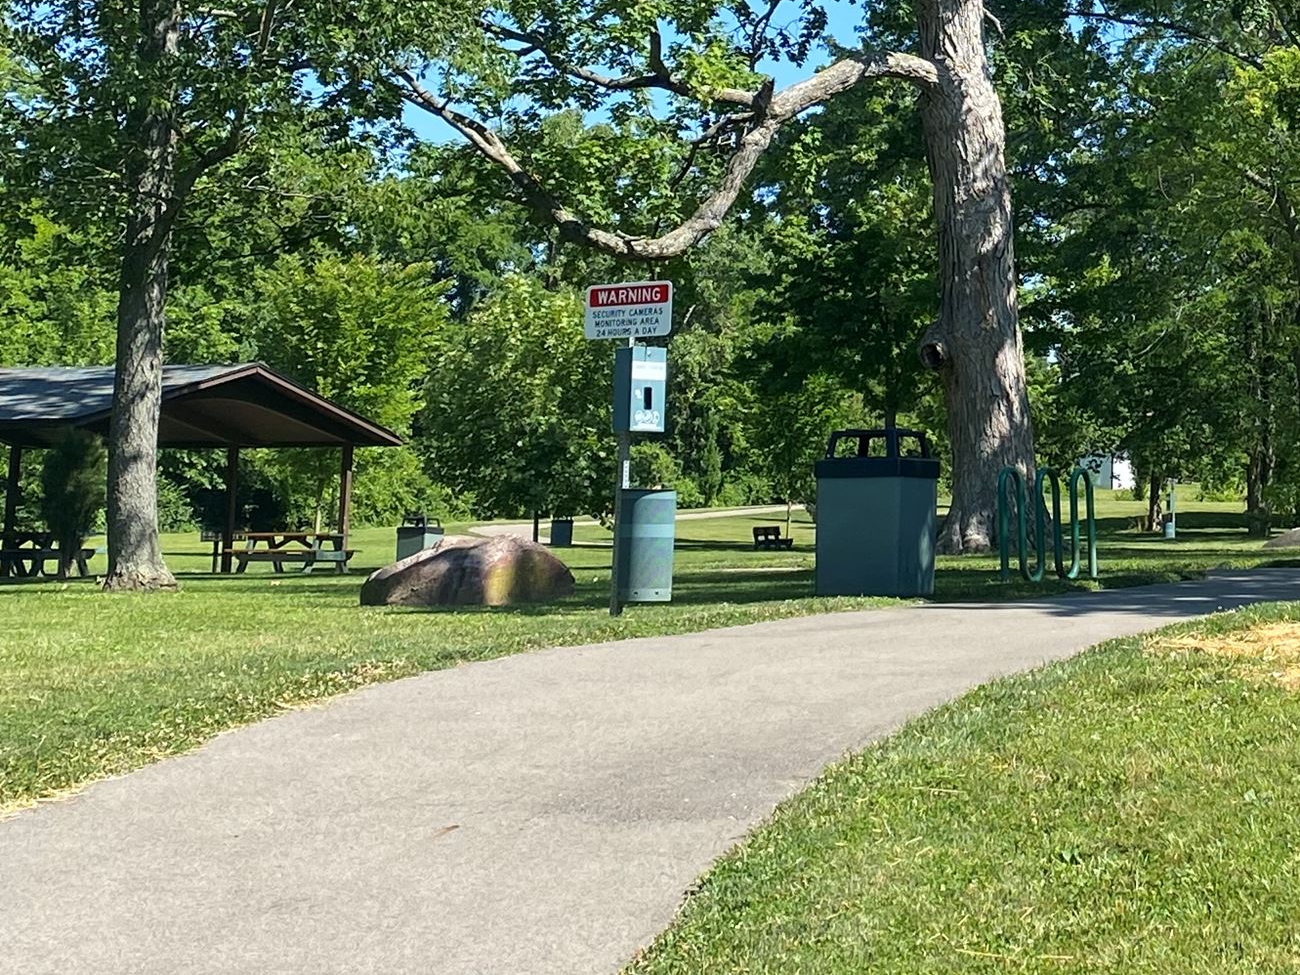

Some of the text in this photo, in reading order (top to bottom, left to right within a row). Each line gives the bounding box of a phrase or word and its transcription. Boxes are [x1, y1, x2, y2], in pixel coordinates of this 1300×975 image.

[598, 288, 661, 304] WARNING
[592, 307, 663, 319] SECURITY CAMERAS
[594, 317, 660, 328] MONITORING AREA
[596, 327, 657, 337] 24 HOURS A DAY
